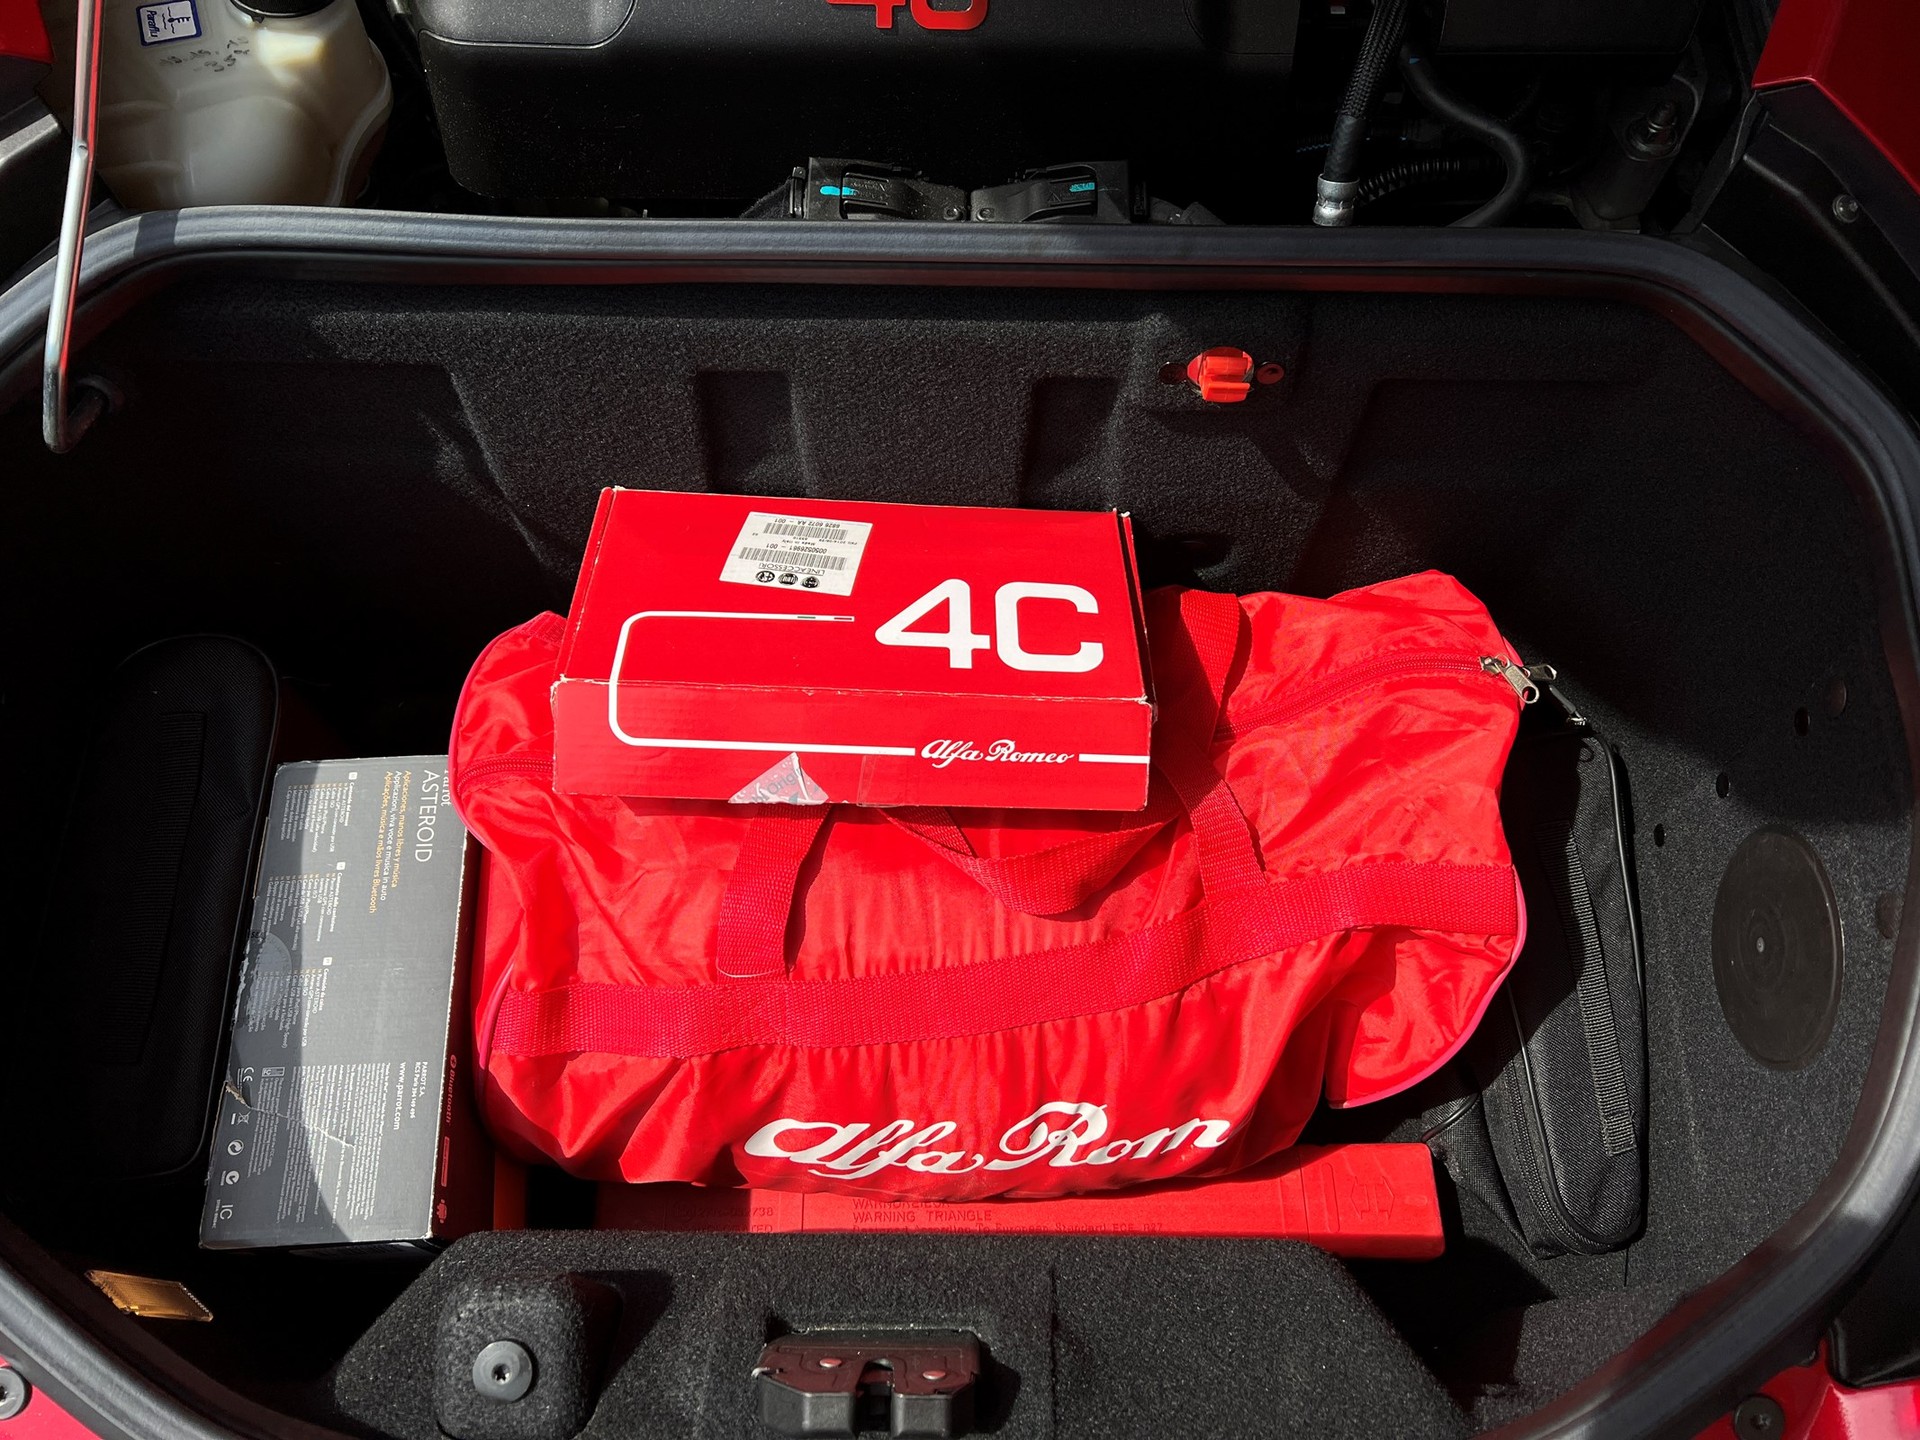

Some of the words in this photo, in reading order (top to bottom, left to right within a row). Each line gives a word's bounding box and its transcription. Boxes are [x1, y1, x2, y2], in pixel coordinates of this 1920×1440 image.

[146, 10, 160, 37] Paraflu
[874, 578, 1104, 673] 4C
[921, 740, 984, 768] Alfa
[985, 740, 1074, 764] Romeo
[380, 771, 393, 808] Aplicações,
[389, 770, 402, 812] Applicazioni,
[398, 770, 411, 814] Aplicaciones,
[378, 809, 388, 833] música
[388, 813, 396, 827] viva
[413, 769, 440, 862] ASTEROID
[375, 839, 384, 858] mãos
[394, 838, 404, 856] libres
[373, 859, 382, 877] livres
[382, 851, 392, 875] musica
[390, 863, 401, 887] música
[368, 878, 380, 913] Bluetooth
[379, 884, 387, 900] auto
[391, 1061, 406, 1130] www.parrot.com
[444, 1068, 456, 1124] Bluetooth
[744, 1118, 984, 1180] Alfa
[984, 1101, 1232, 1170] Rom
[853, 1210, 916, 1222] WARNING
[928, 1210, 992, 1222] TRIANGLE
[976, 1223, 990, 1232] To
[1056, 1224, 1106, 1232] Standard
